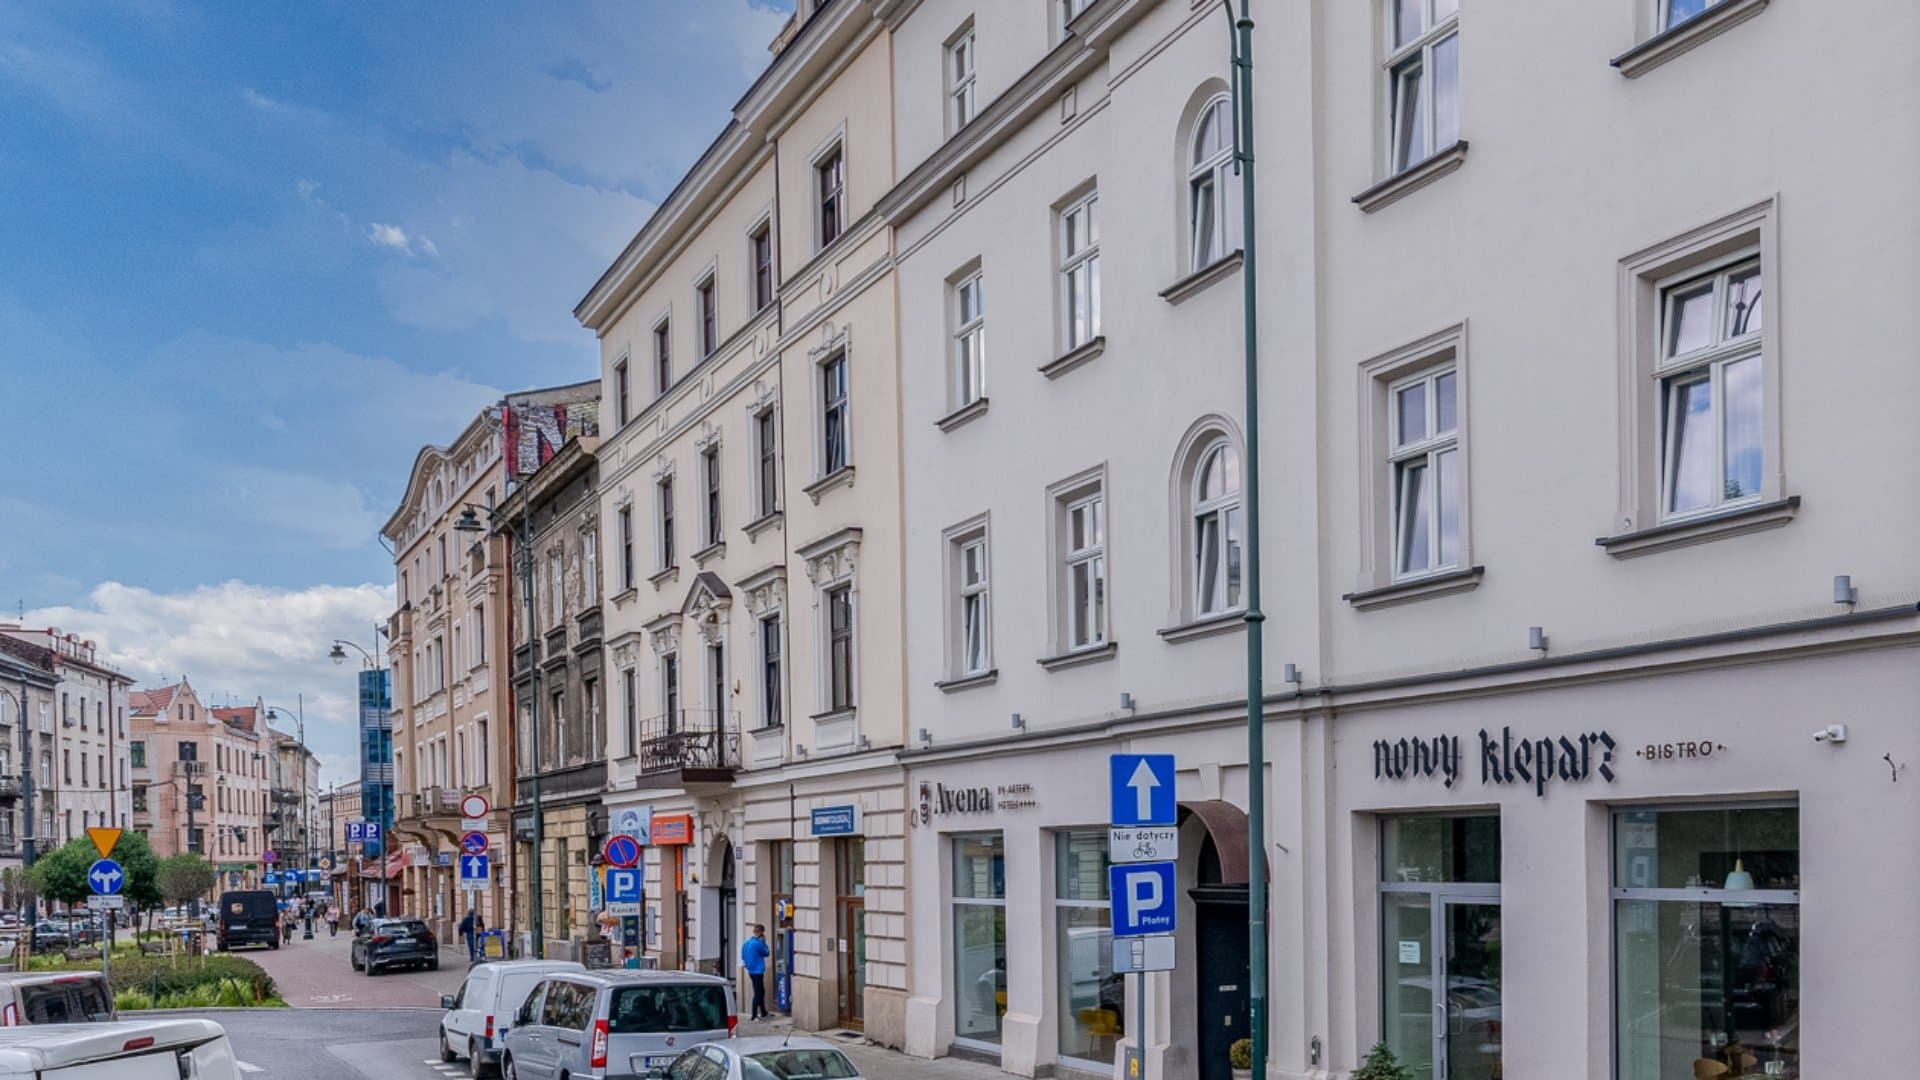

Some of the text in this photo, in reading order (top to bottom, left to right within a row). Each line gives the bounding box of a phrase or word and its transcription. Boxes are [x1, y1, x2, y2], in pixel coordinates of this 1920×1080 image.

[1373, 734, 1459, 789] nowy
[1645, 741, 1713, 761] BISTRO
[934, 782, 991, 814] Avena
[1113, 831, 1174, 841] Nie dotyczy
[614, 872, 634, 898] P
[1126, 871, 1163, 927] P
